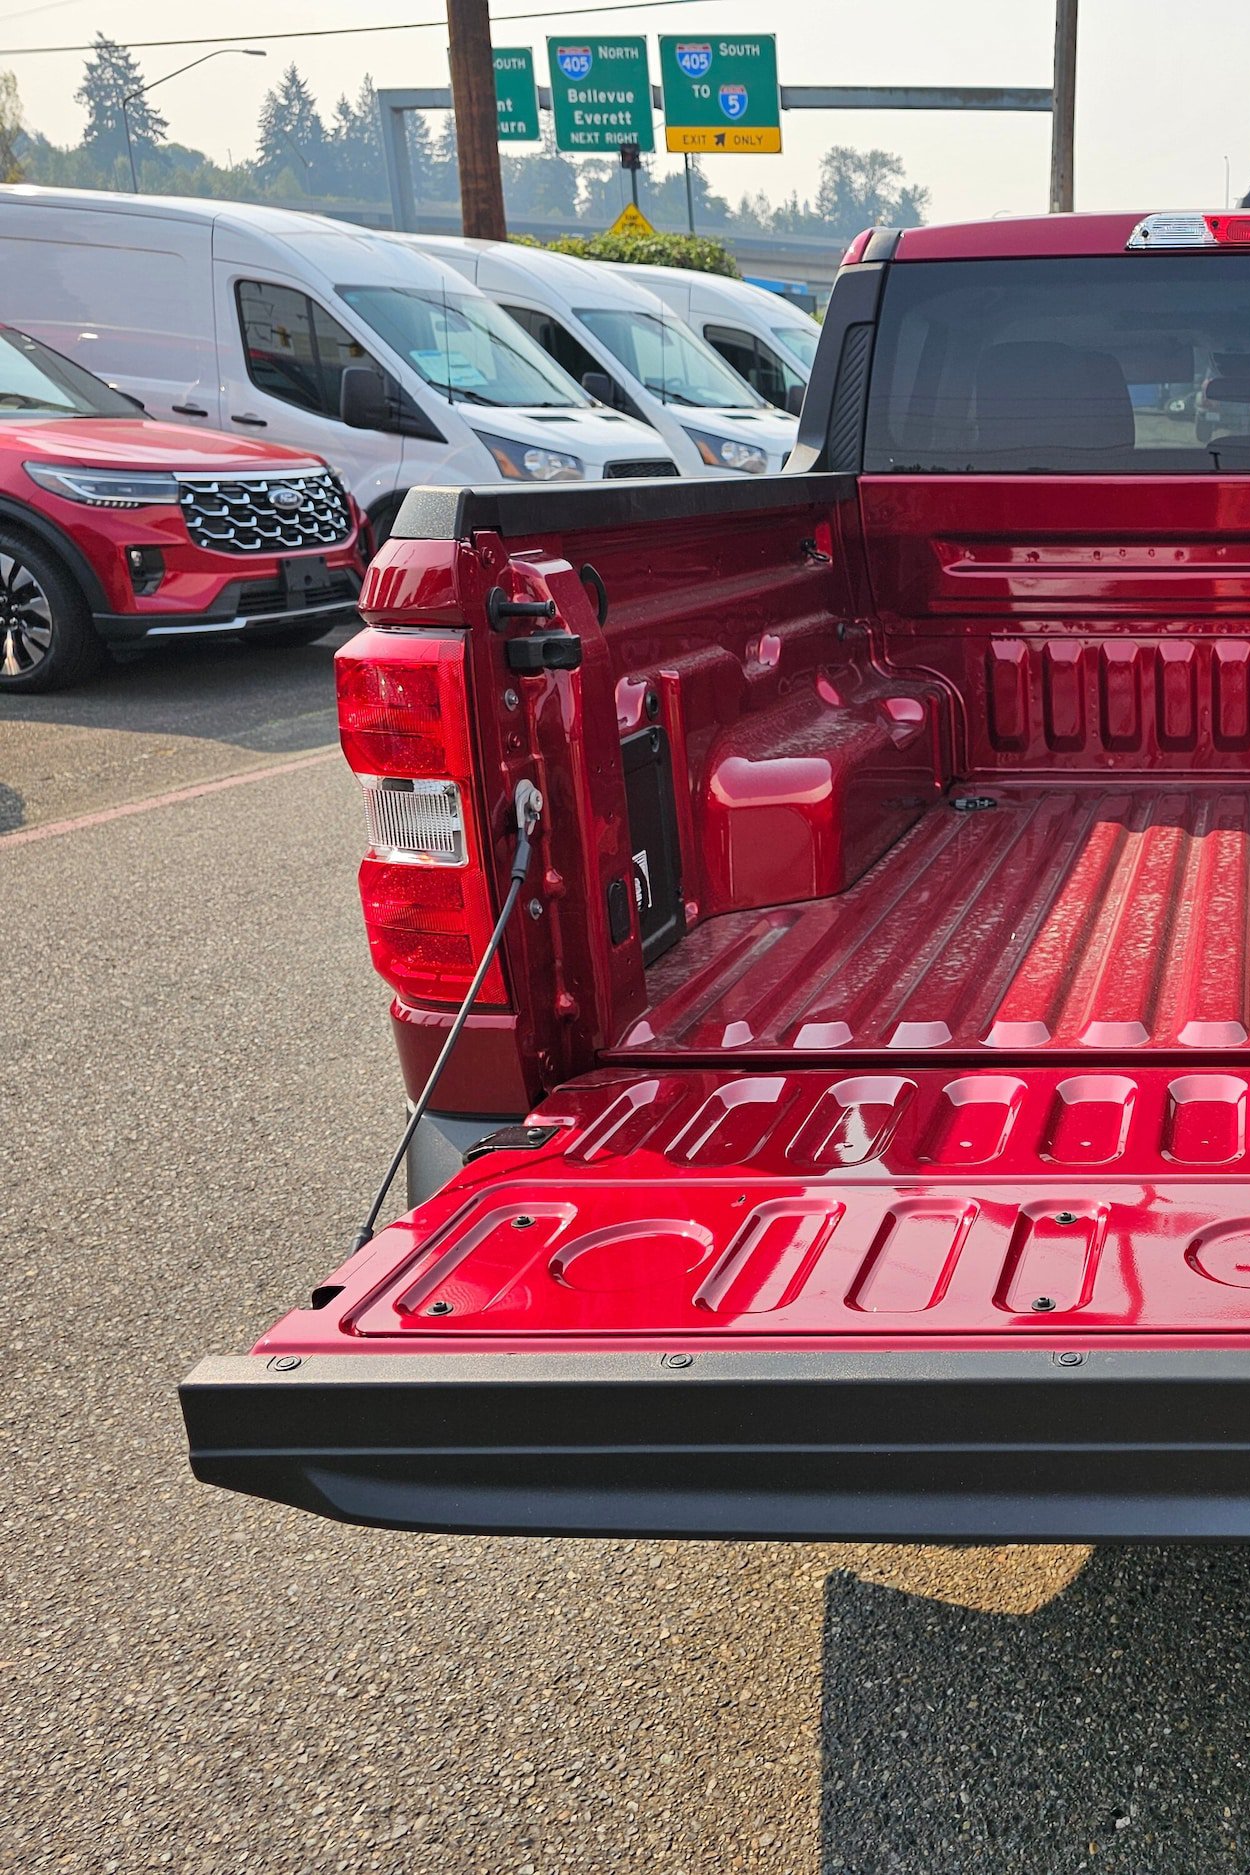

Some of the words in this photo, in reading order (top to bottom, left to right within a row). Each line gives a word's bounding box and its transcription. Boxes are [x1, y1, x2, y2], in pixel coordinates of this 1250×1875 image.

[563, 56, 589, 72] 405
[598, 45, 639, 59] NORTH
[681, 53, 709, 70] 405
[719, 42, 760, 56] SOUTH
[567, 88, 634, 104] Bellevue
[692, 84, 711, 98] TO
[728, 95, 740, 114] 5
[574, 110, 632, 126] Everett
[498, 120, 527, 133] urn
[570, 131, 600, 144] NEXT
[604, 131, 639, 145] RIGHT
[683, 135, 706, 145] EXIT
[734, 135, 763, 145] ONLY
